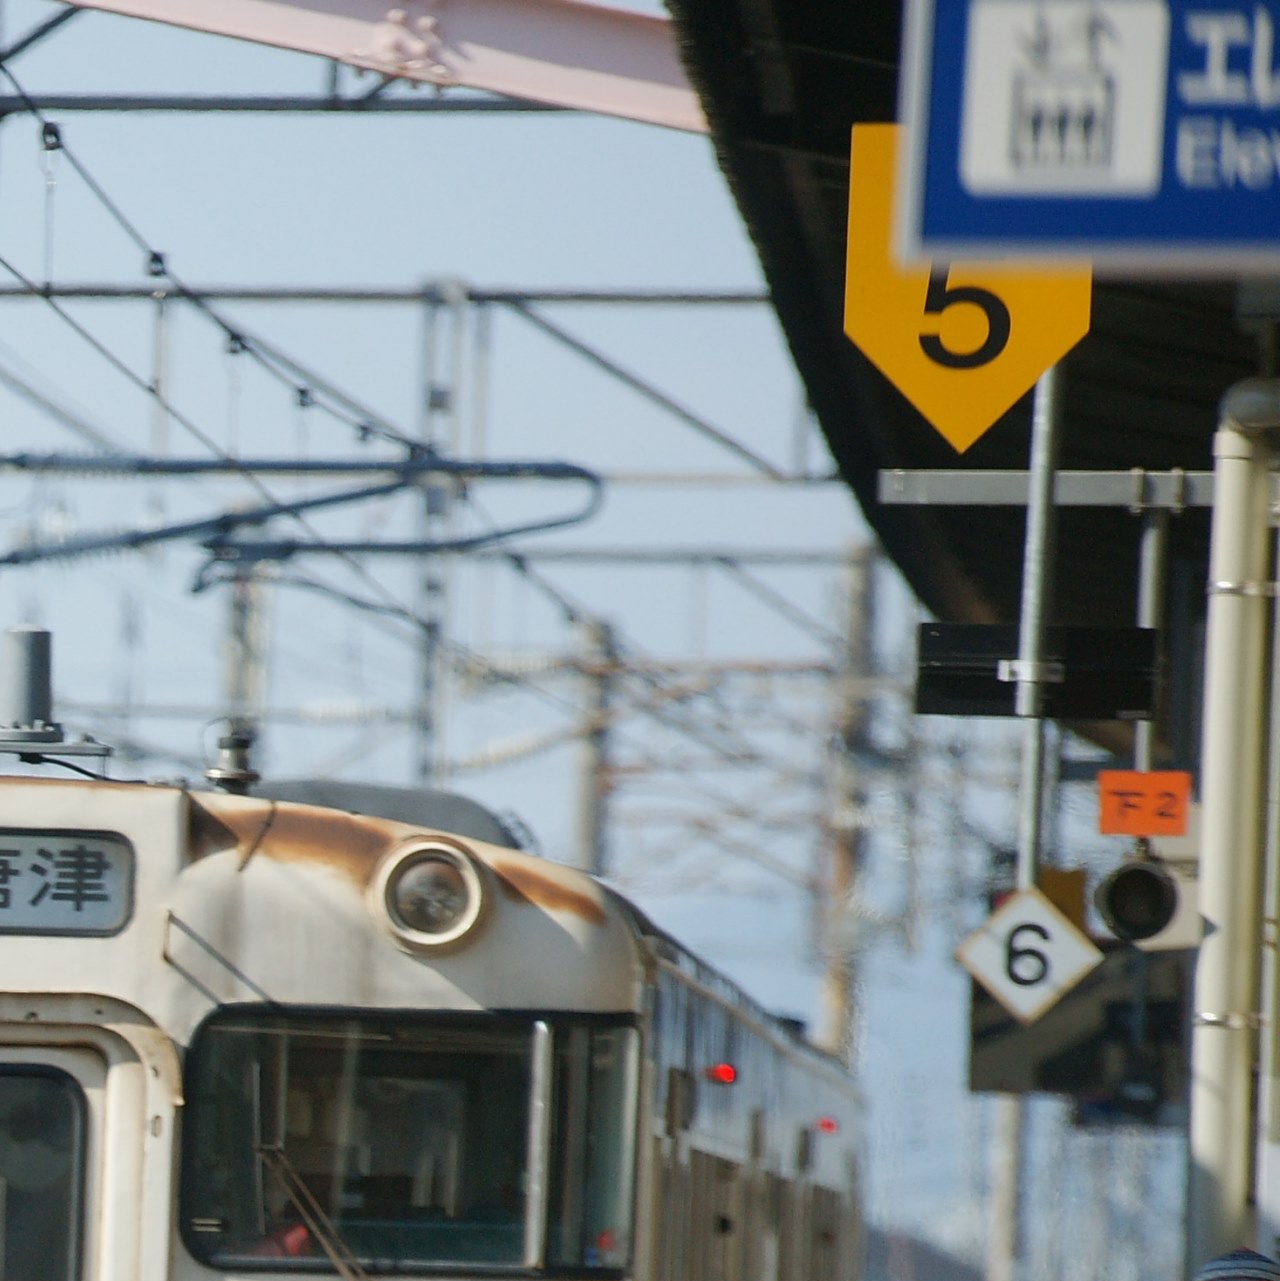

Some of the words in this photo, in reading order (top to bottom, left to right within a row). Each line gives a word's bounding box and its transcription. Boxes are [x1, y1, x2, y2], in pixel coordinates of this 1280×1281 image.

[1177, 115, 1280, 190] Ele
[918, 254, 1012, 369] 5
[1005, 922, 1053, 987] 6
